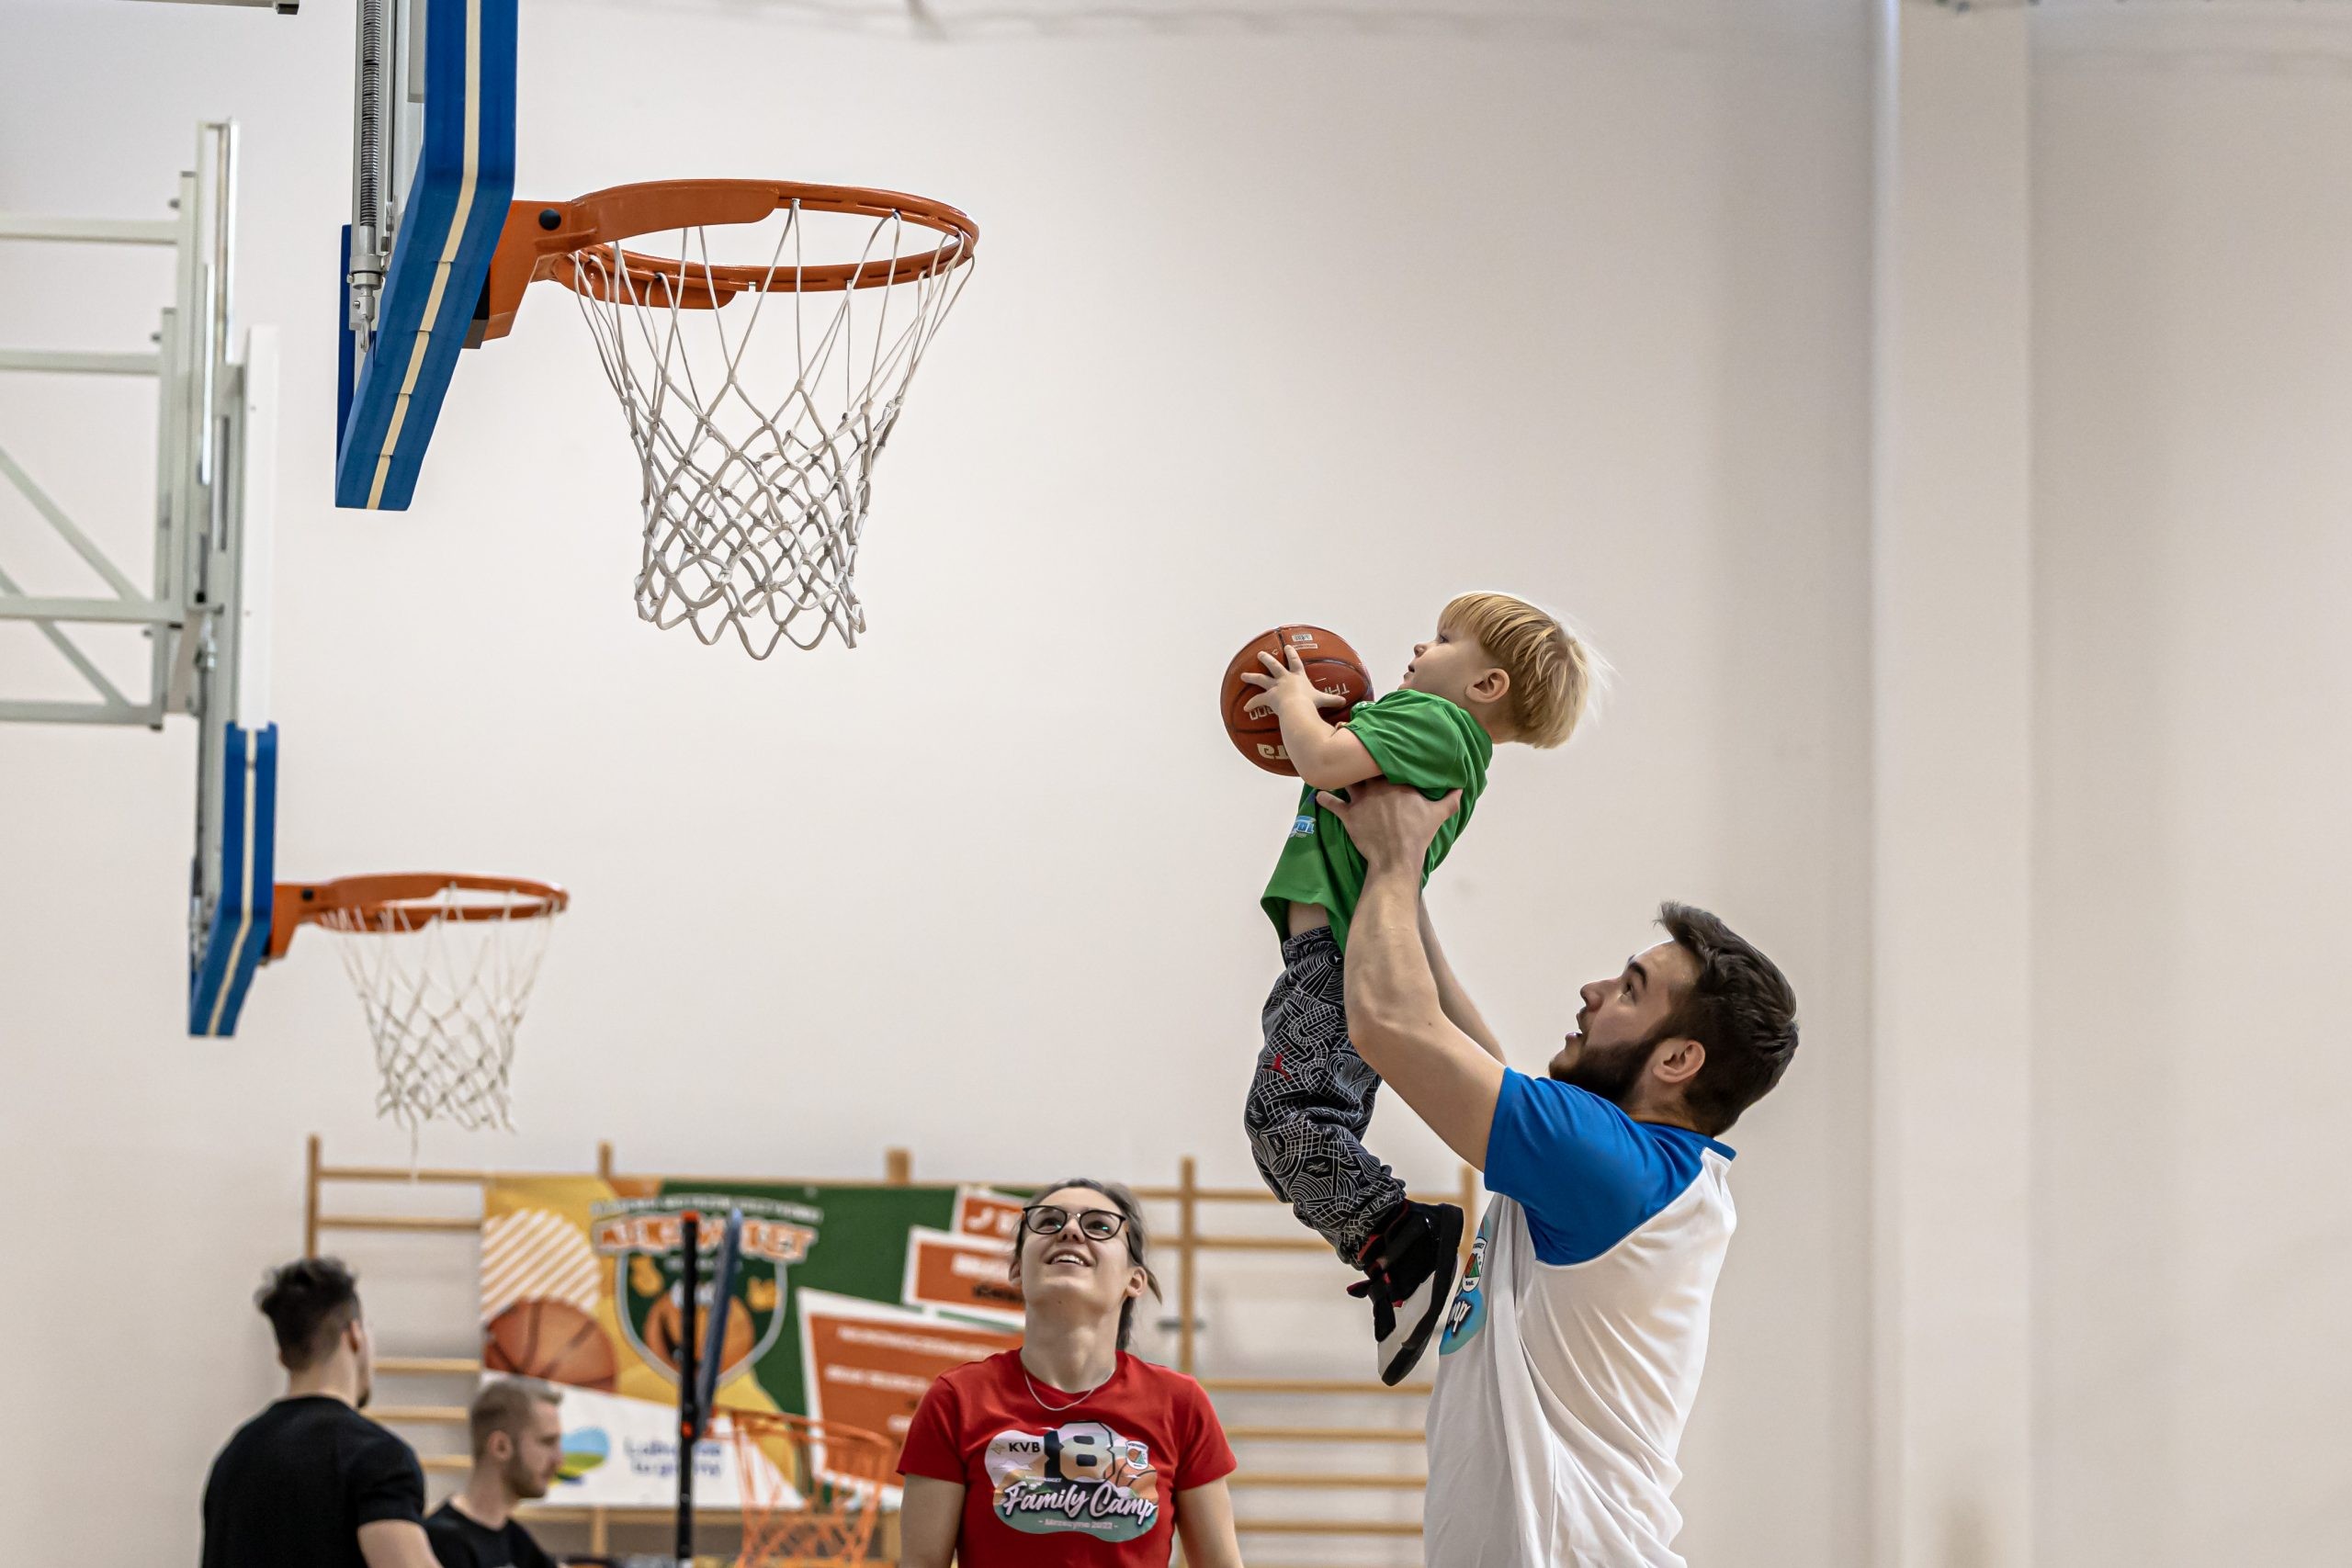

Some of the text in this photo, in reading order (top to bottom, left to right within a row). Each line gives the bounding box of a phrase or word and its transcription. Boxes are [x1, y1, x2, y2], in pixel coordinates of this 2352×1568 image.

[1009, 1441, 1041, 1453] KVB
[1002, 1481, 1159, 1526] Family Camp
